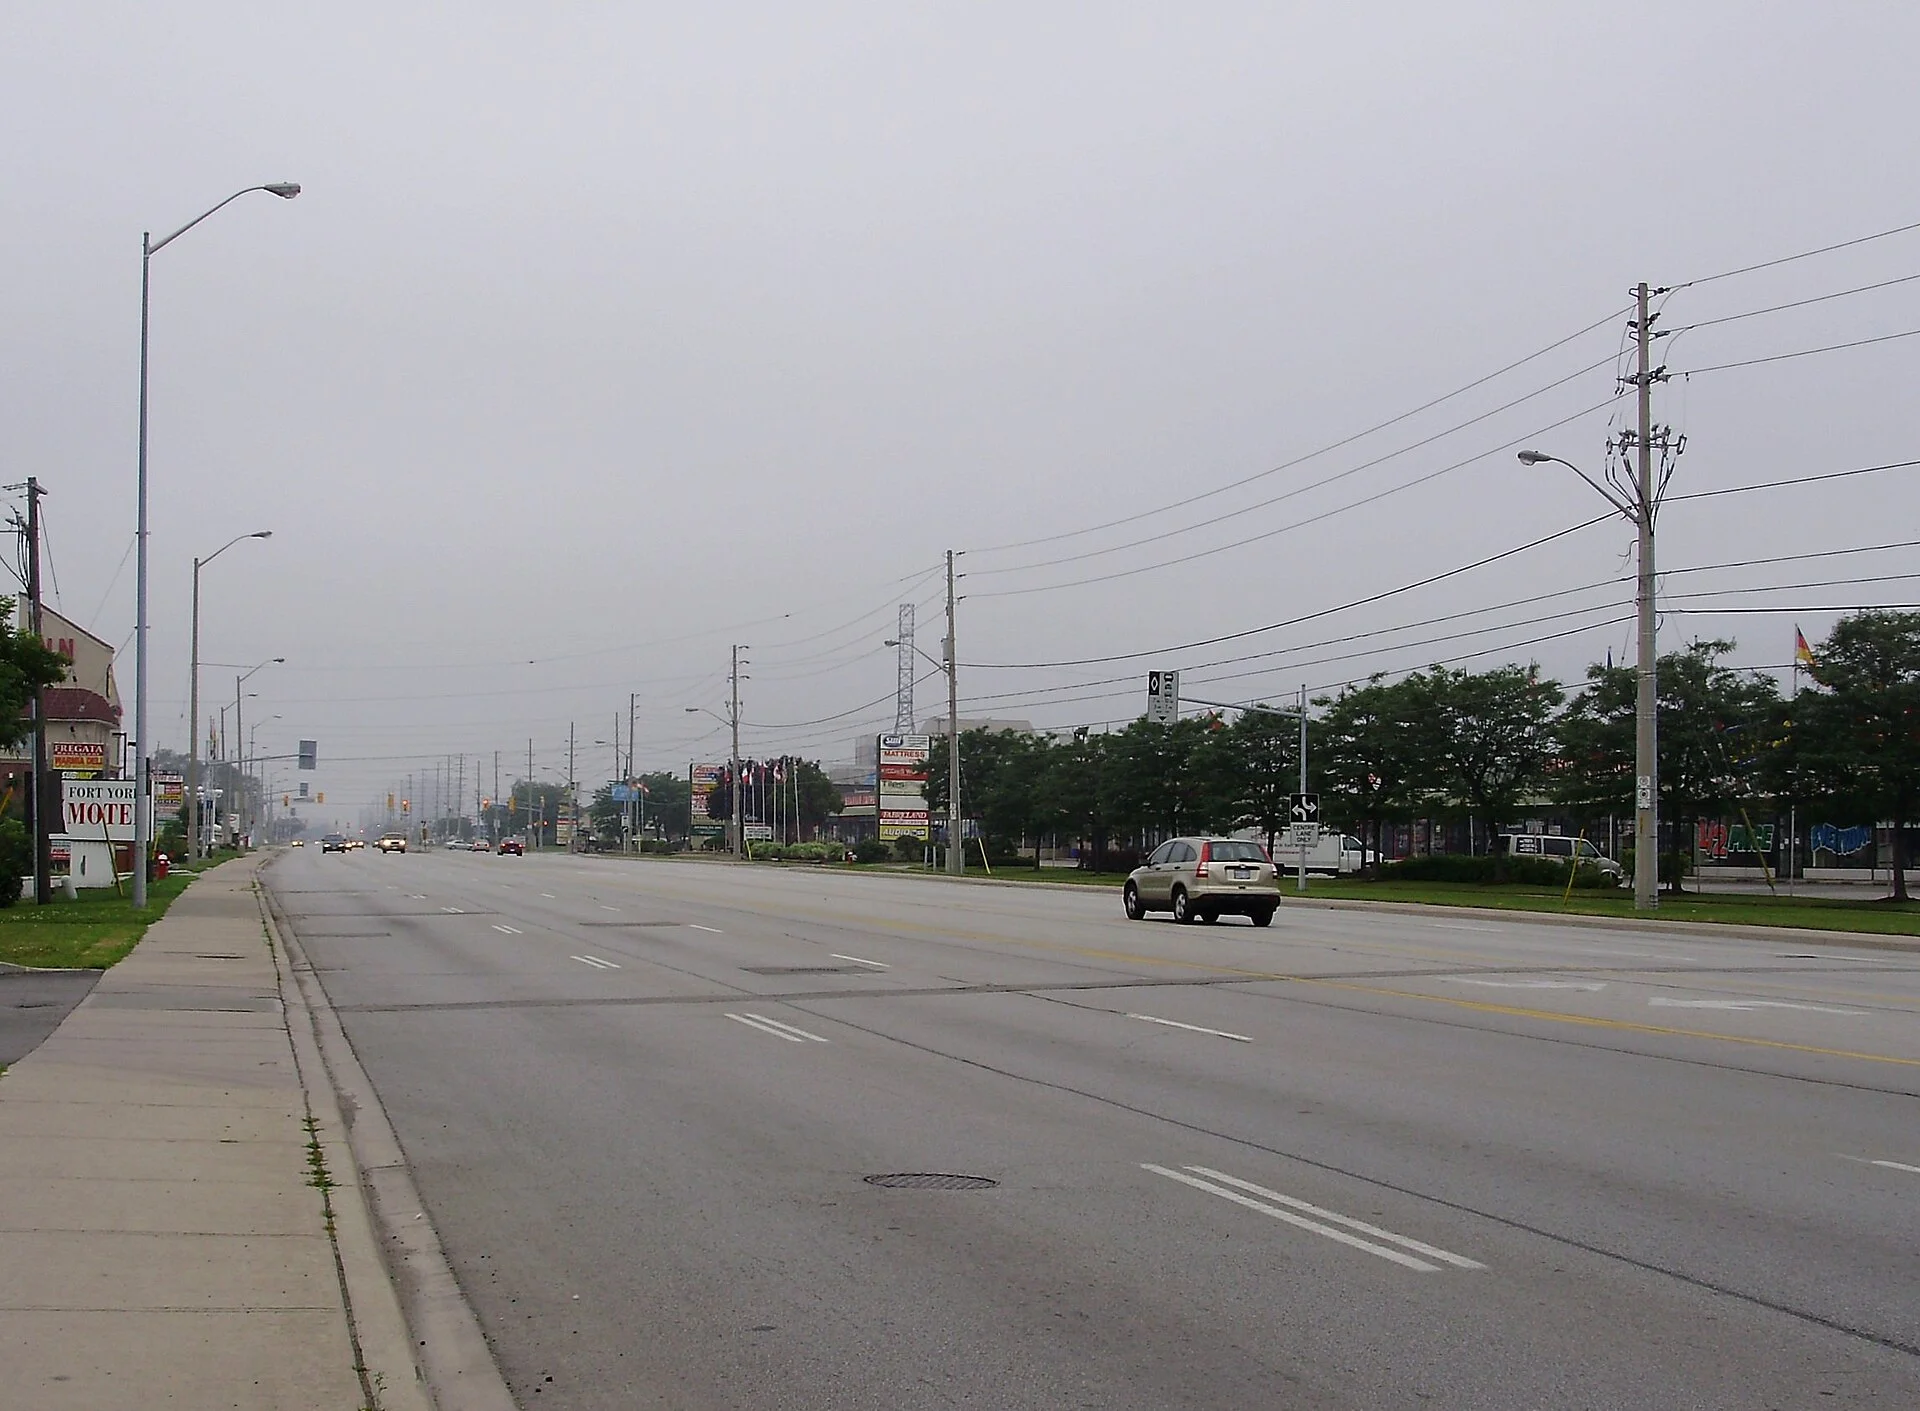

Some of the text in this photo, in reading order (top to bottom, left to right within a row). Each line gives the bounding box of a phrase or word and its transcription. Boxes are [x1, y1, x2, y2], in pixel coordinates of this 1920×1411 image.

[54, 744, 103, 753] FREGATA
[69, 787, 136, 799] FORT YOR
[68, 802, 136, 826] MOTE
[882, 828, 910, 836] AUDIO
